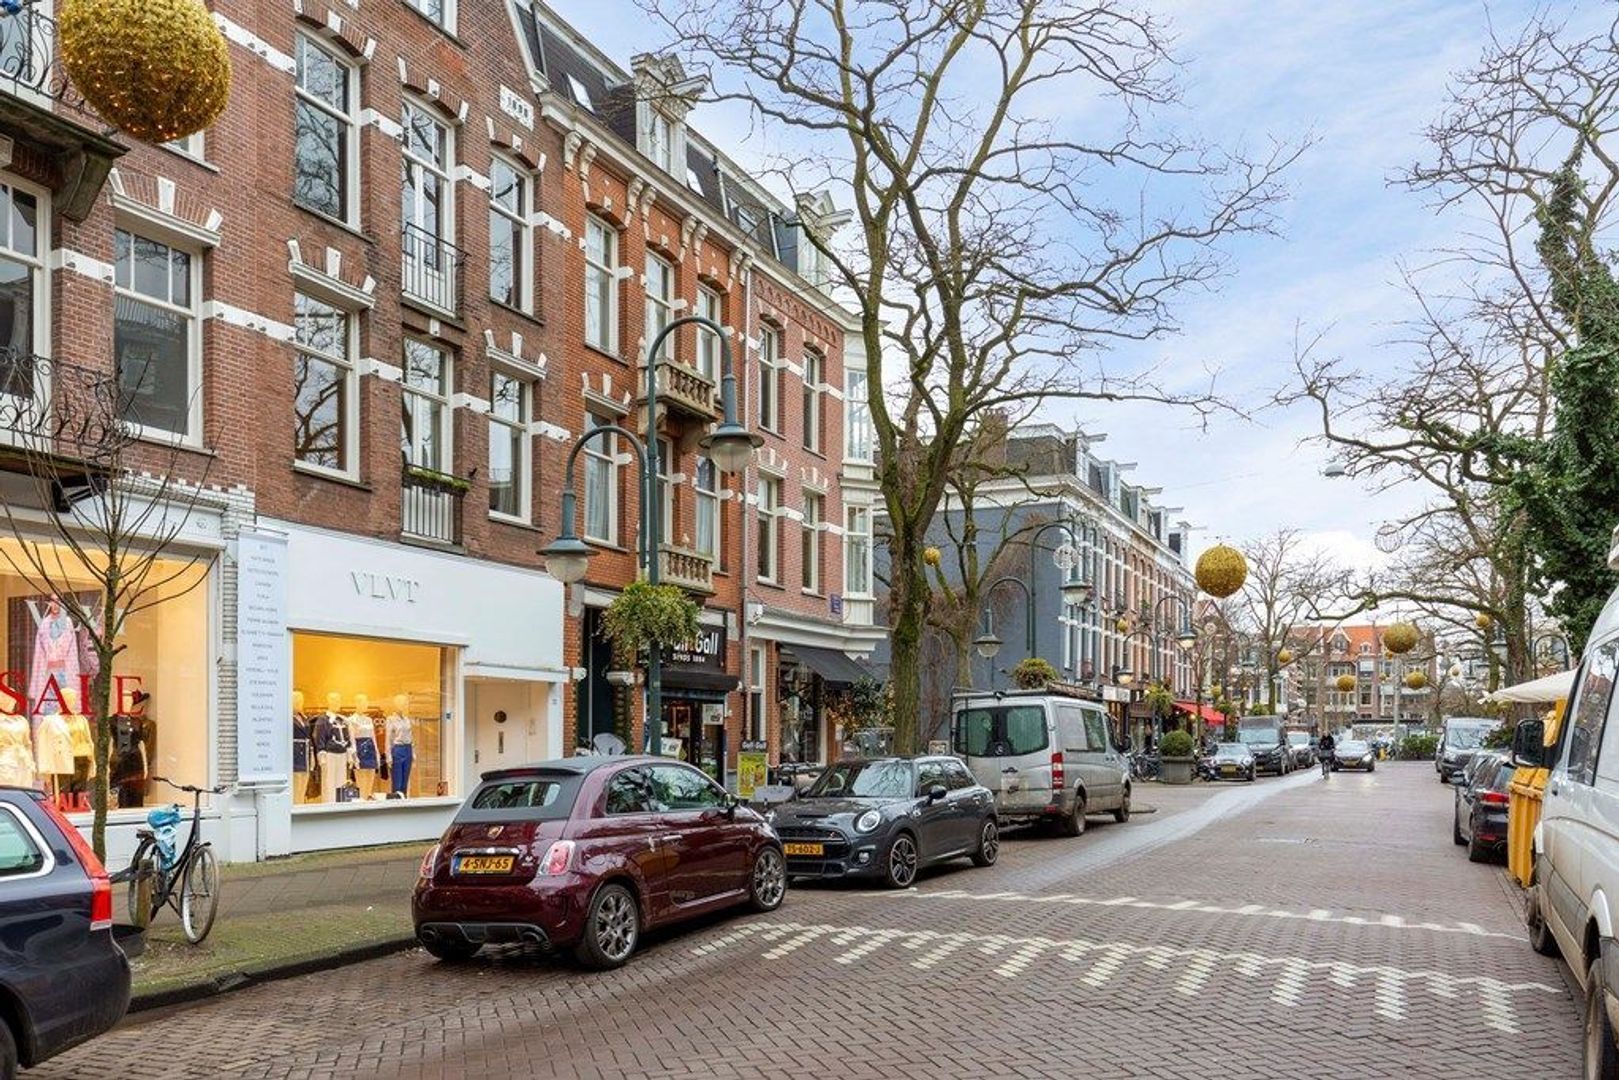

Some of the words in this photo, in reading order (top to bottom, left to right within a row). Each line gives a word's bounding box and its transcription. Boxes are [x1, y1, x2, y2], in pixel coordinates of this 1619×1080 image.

[350, 571, 420, 604] VLVT
[695, 630, 719, 655] Gall
[0, 671, 146, 717] SALE
